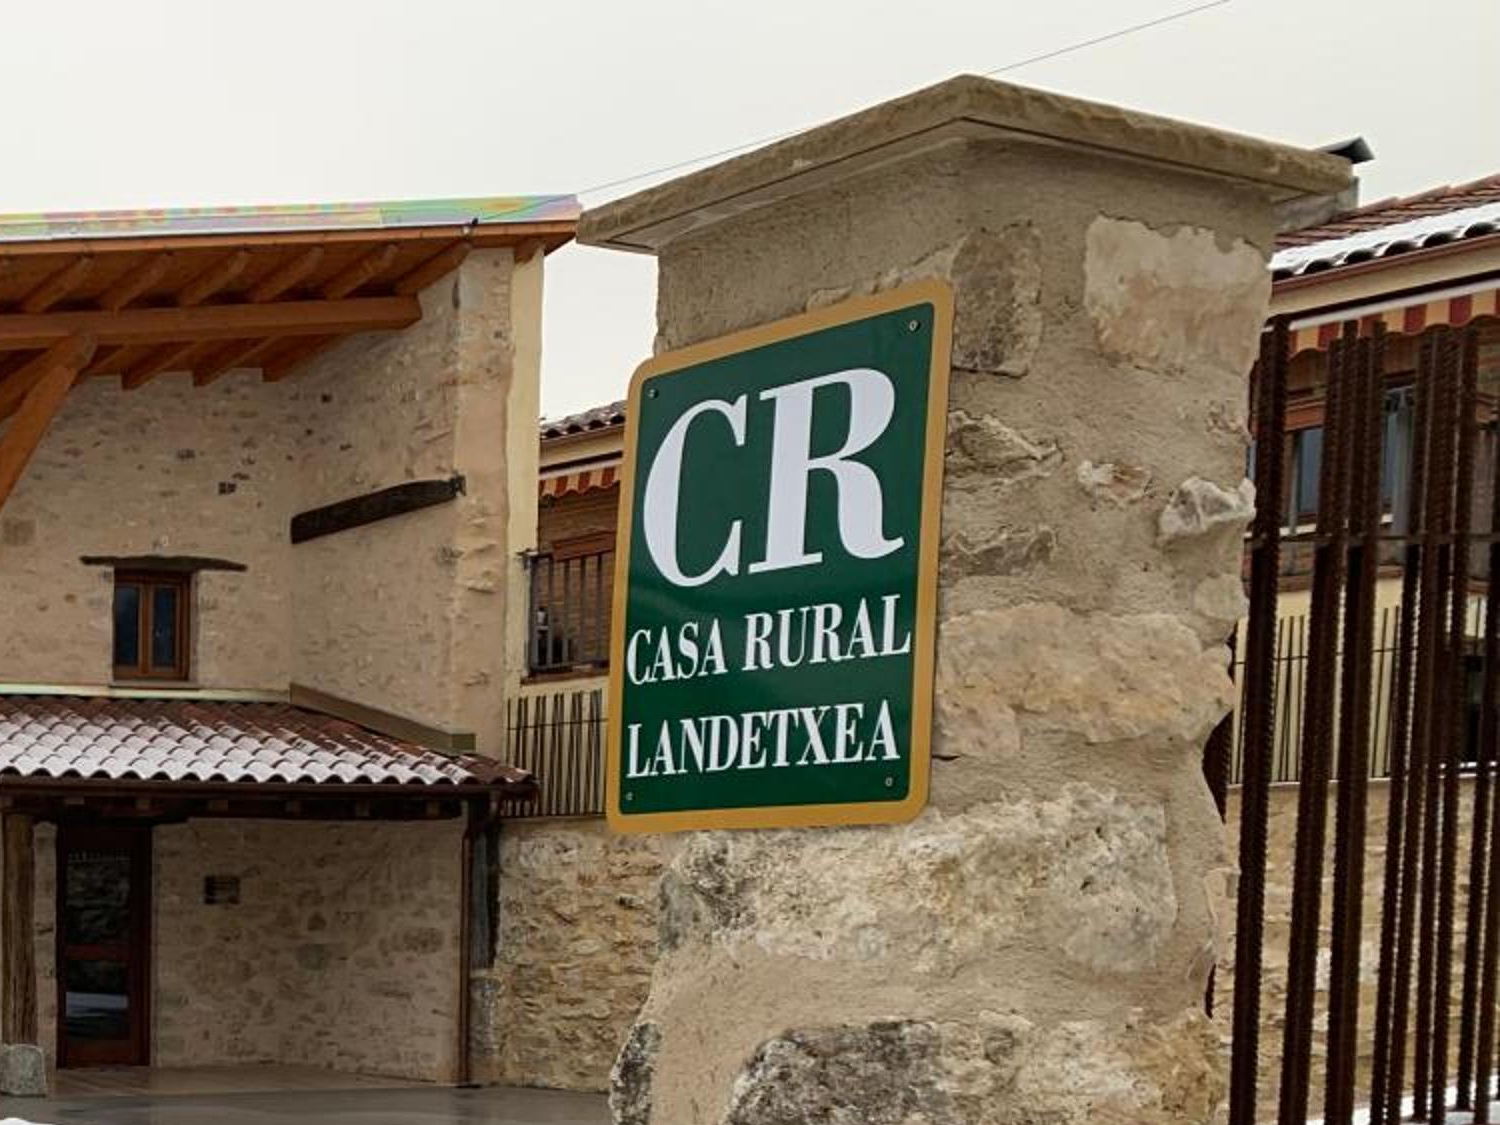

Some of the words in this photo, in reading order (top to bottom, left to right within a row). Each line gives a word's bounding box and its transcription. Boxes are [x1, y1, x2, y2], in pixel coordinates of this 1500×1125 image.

[643, 368, 904, 587] CR
[626, 618, 728, 685] CASA
[742, 594, 911, 672] RURAL
[627, 699, 901, 778] LANDETXEA
